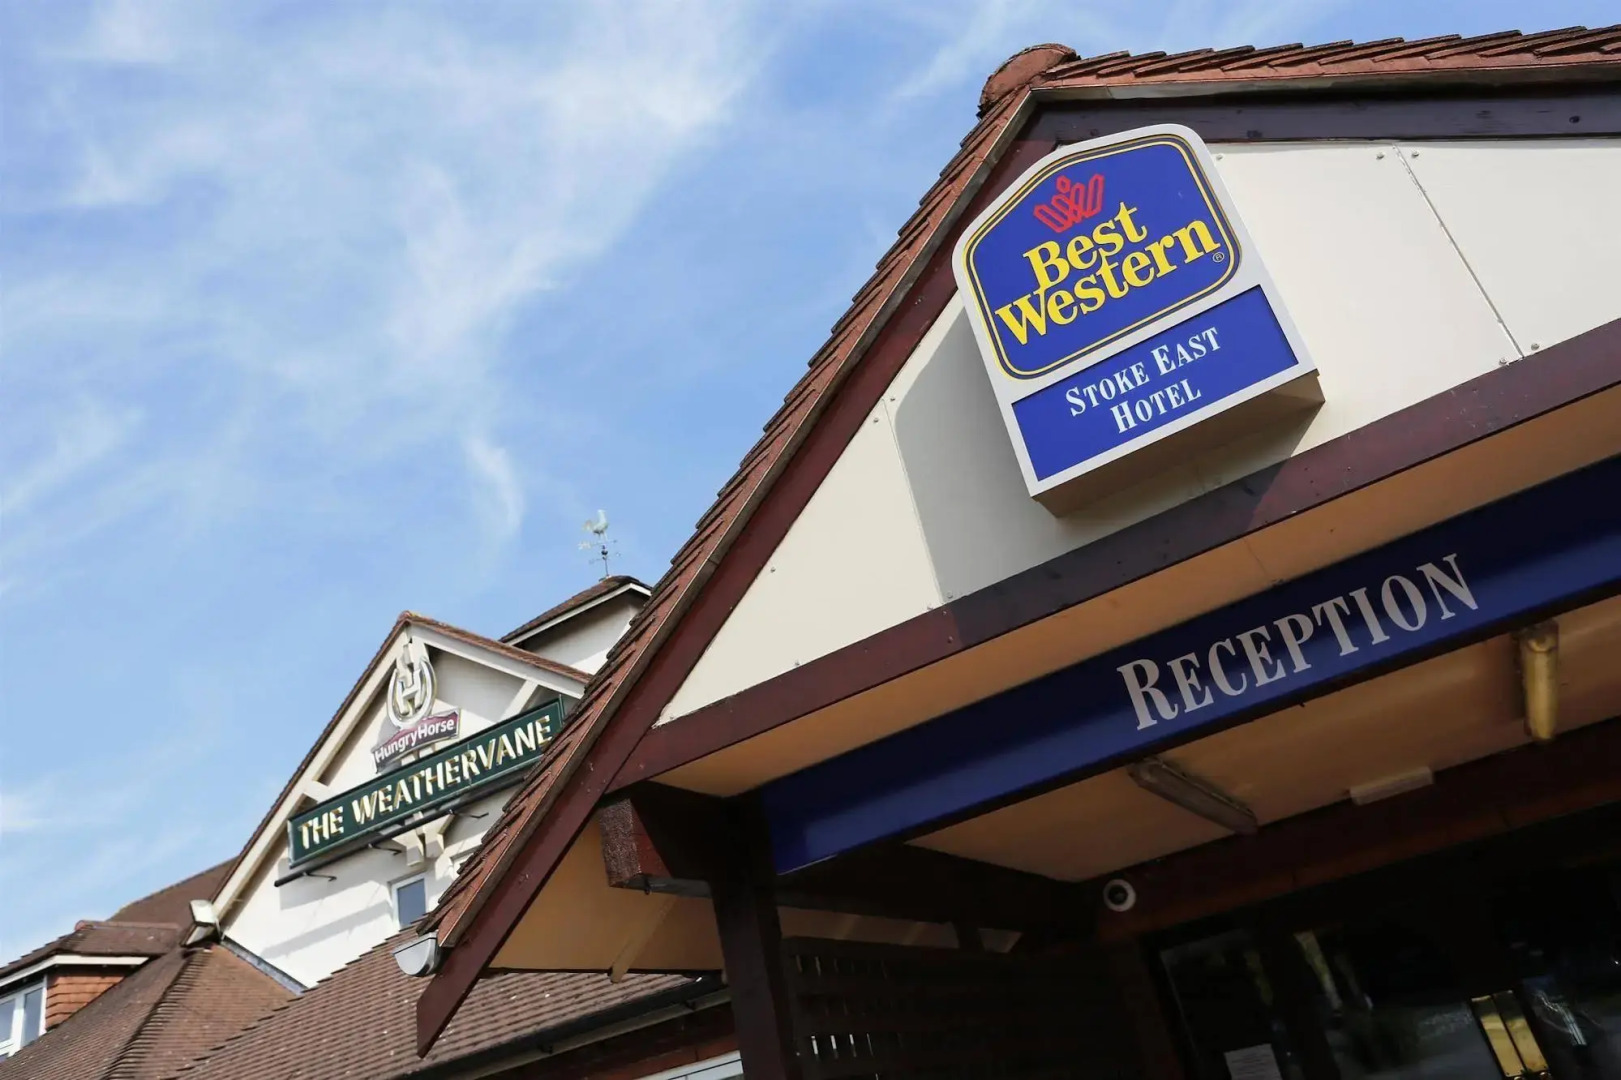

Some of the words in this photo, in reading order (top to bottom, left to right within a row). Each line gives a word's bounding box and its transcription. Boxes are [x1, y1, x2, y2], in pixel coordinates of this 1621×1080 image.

[994, 218, 1221, 346] Western
[1022, 201, 1148, 290] Best
[1065, 361, 1150, 417] STOKE
[1150, 326, 1222, 377] EAST
[1110, 378, 1202, 434] HOTEL
[1116, 553, 1479, 731] RECEPTION
[298, 805, 345, 850] THE
[351, 714, 553, 825] WEATHERVANE
